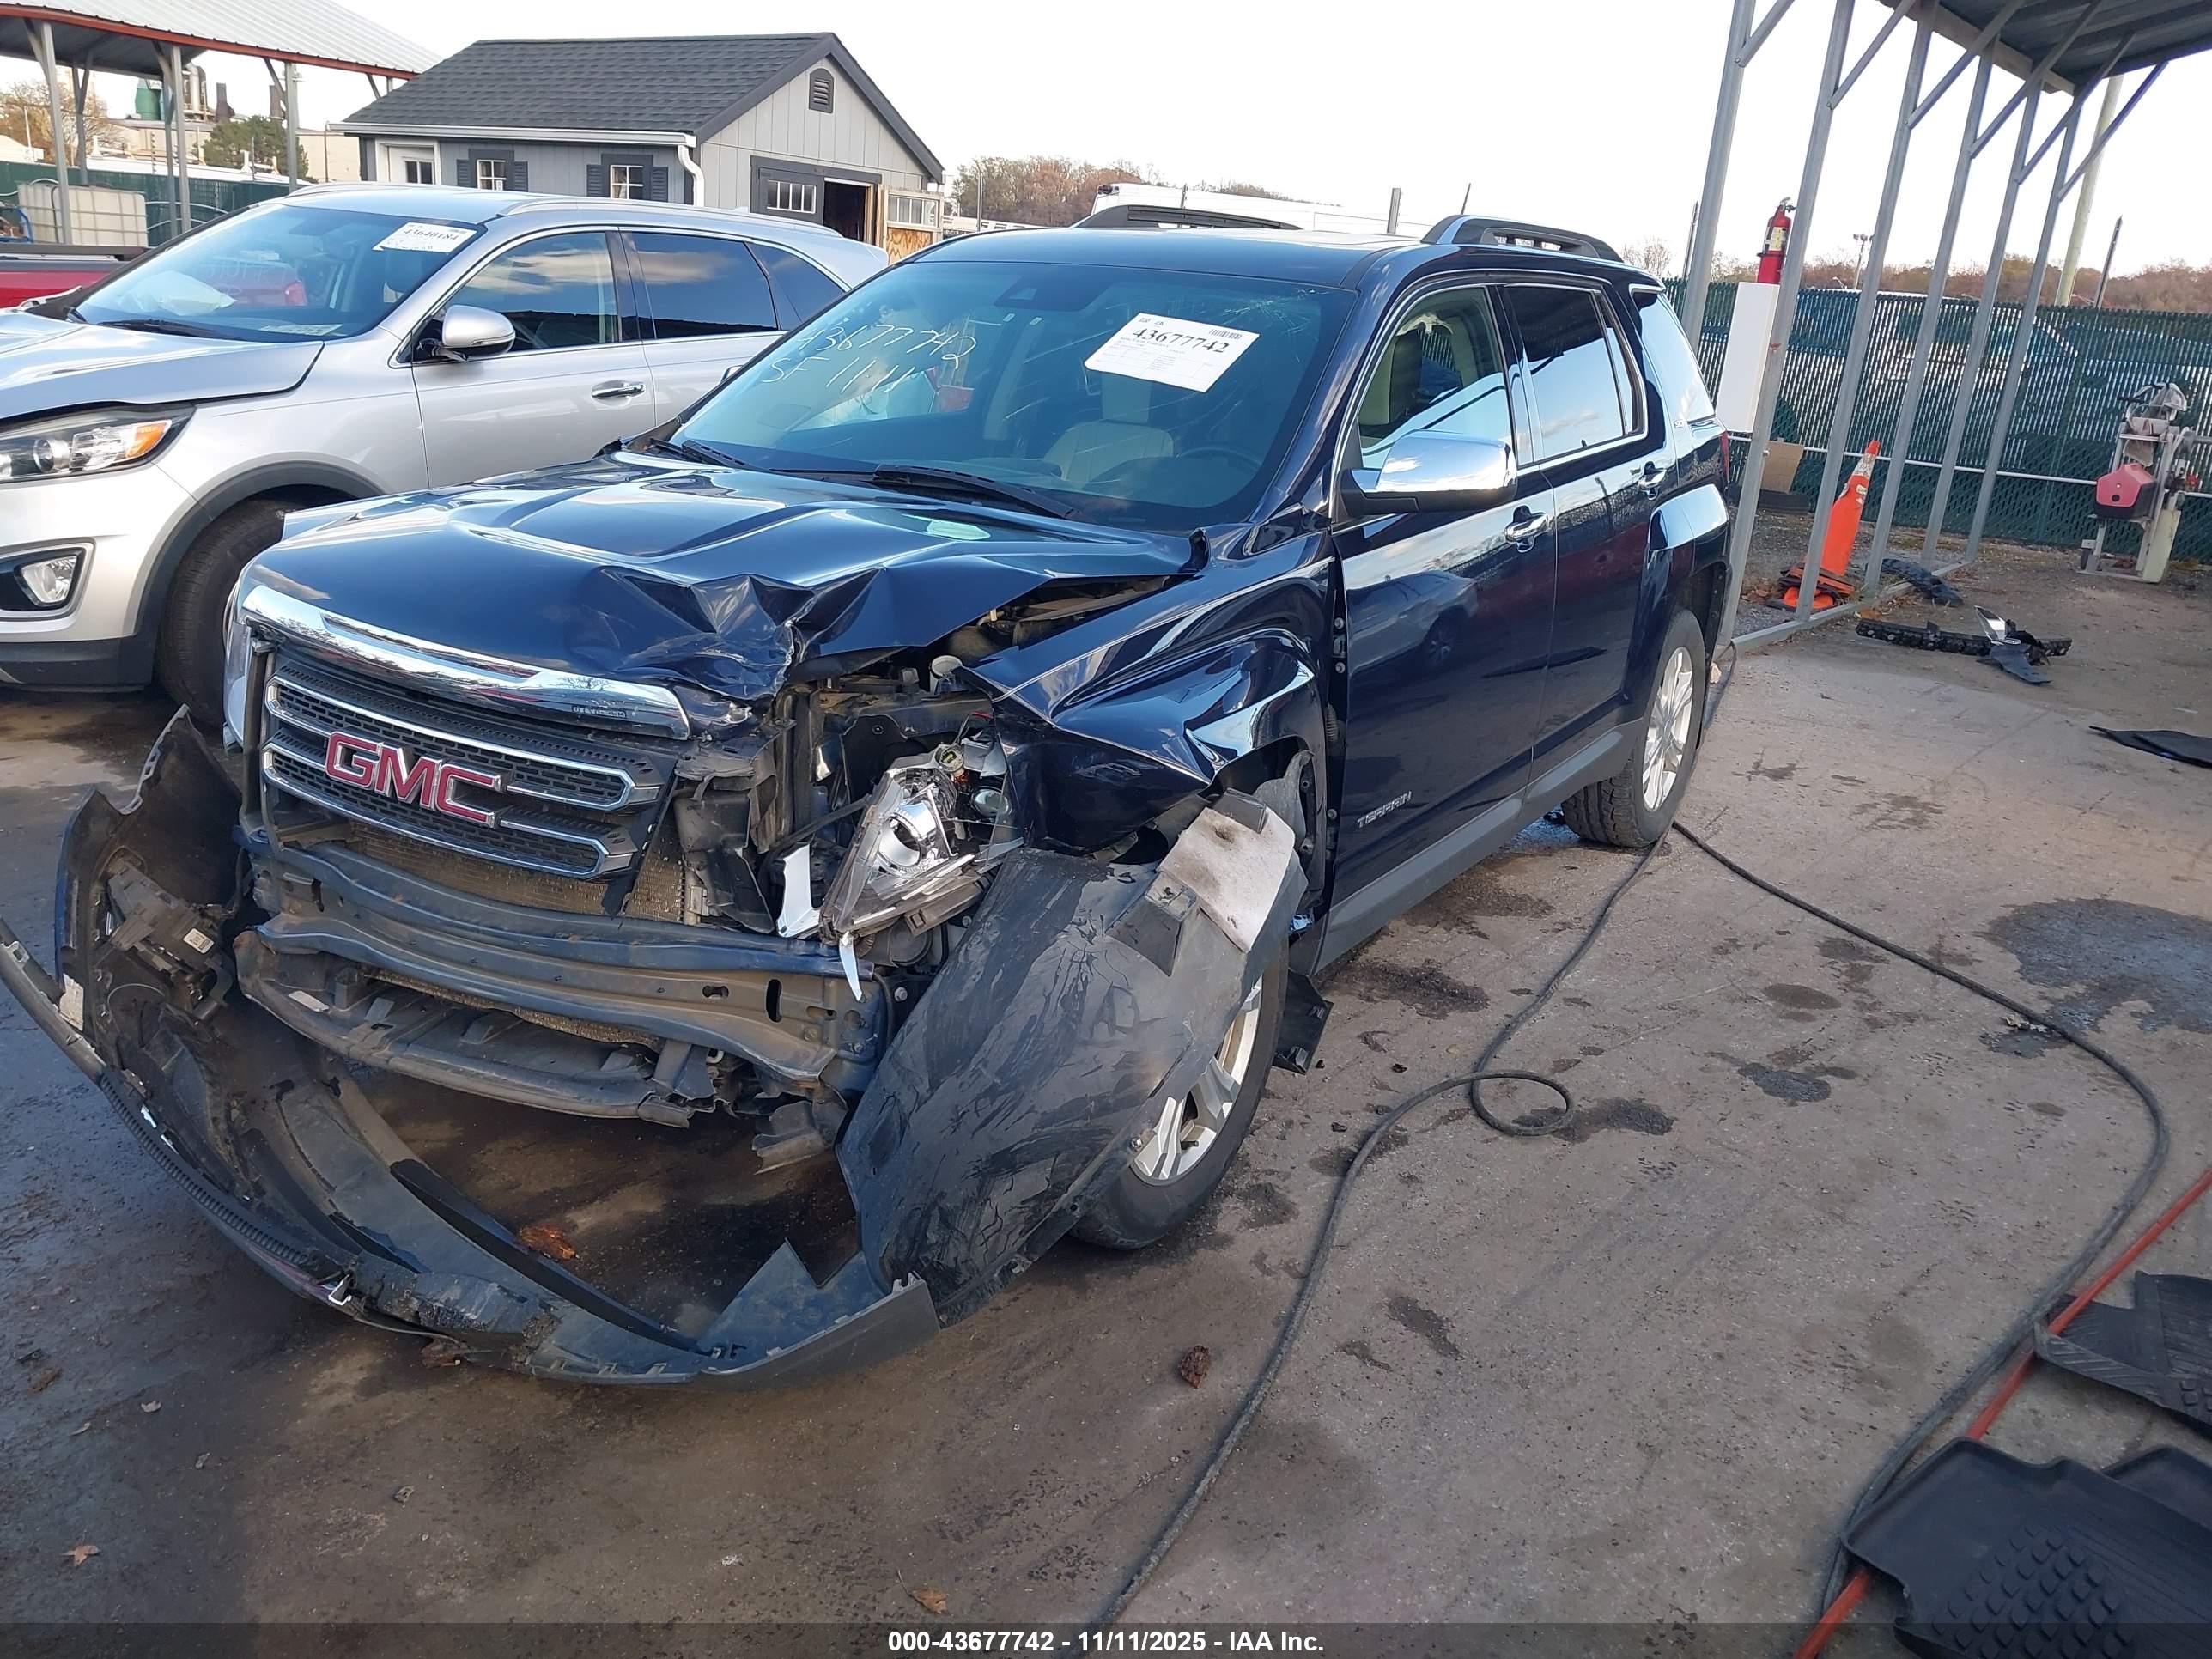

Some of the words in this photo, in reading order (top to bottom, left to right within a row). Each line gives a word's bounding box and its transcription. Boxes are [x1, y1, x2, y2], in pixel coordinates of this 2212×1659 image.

[1133, 327, 1230, 354] 43677742
[762, 356, 830, 384] SF
[325, 730, 502, 829] GMC
[1356, 790, 1413, 829] TERRAIN
